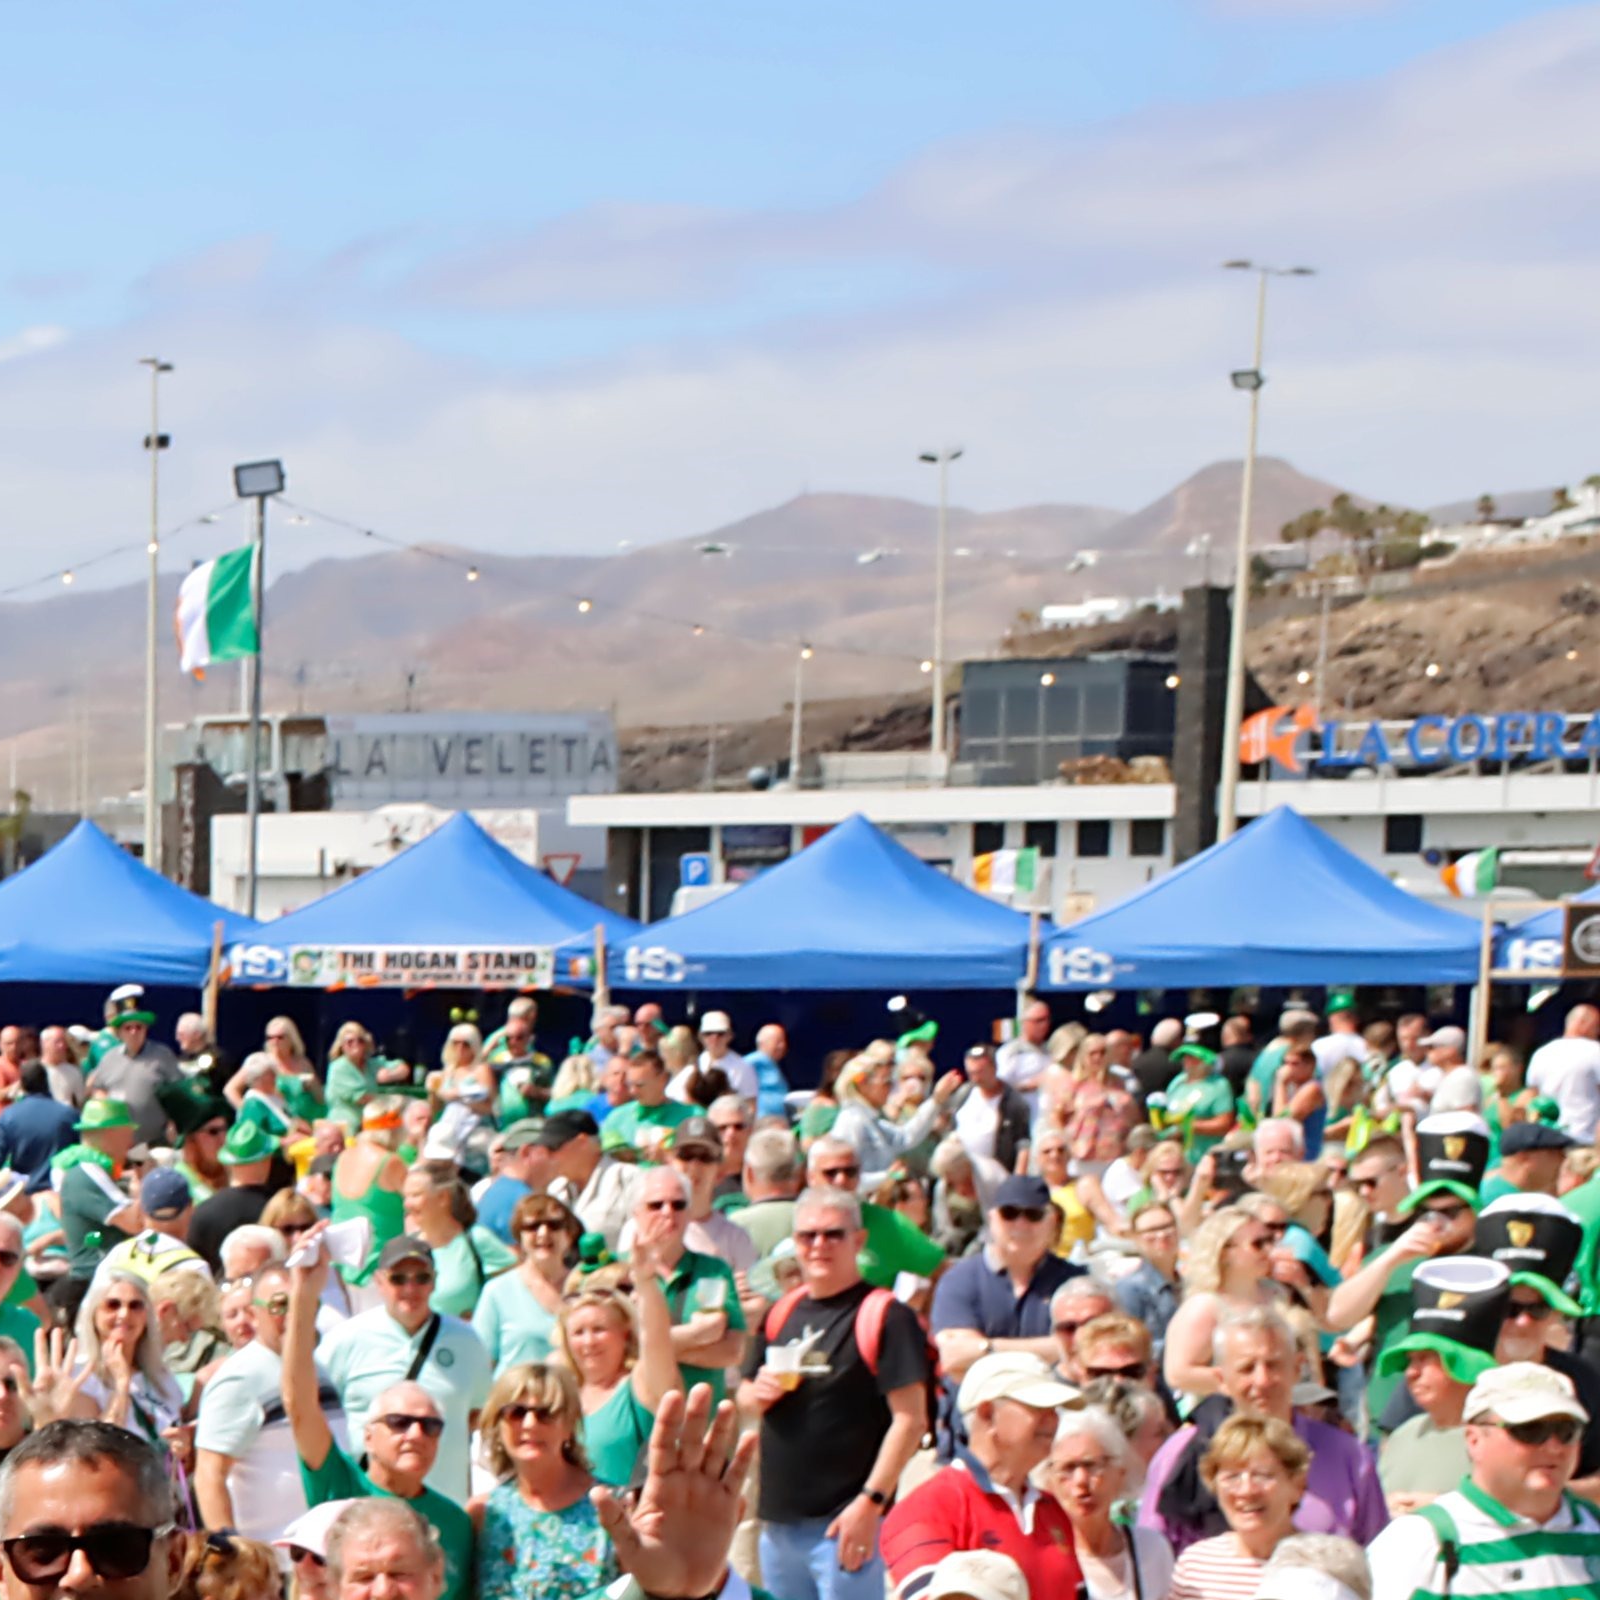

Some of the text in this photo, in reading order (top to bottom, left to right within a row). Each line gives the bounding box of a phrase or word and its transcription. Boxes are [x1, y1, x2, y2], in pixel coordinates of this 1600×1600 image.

[335, 738, 612, 777] LA VELETA
[1320, 722, 1392, 766] LA
[341, 952, 537, 970] THE HOGAN STAND
